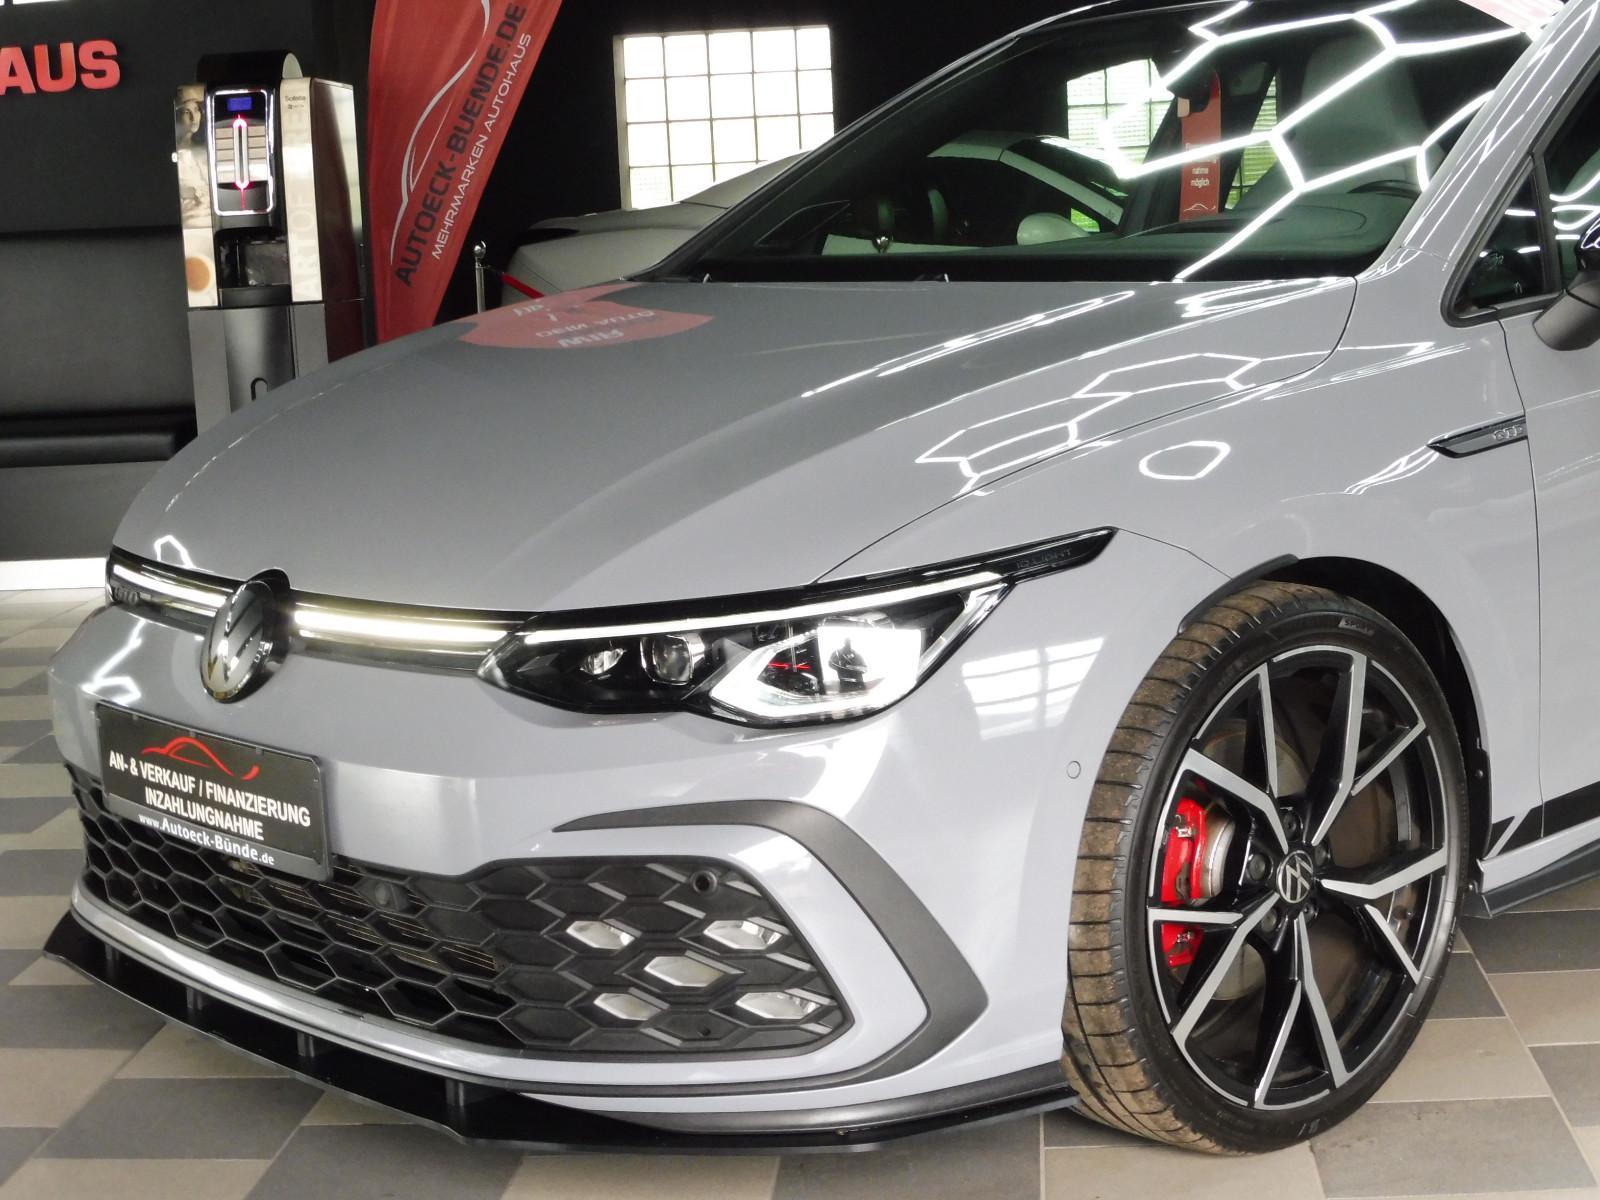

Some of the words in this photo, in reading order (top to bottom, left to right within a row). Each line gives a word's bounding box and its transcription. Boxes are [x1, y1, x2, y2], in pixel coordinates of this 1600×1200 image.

[0, 40, 121, 95] AUS
[395, 3, 527, 287] AUTOECK-BUENDE.DE
[432, 134, 488, 260] MEHRMARKEN
[486, 33, 532, 133] AUTOHAUS
[109, 750, 129, 772] AN-
[130, 757, 138, 777] &
[140, 762, 196, 794] VERKAUF
[206, 779, 311, 827] FINANZIERUNG
[145, 787, 264, 841] INZAHLUNGNAHME
[138, 812, 275, 866] www.Autoeck-Bünde.de
